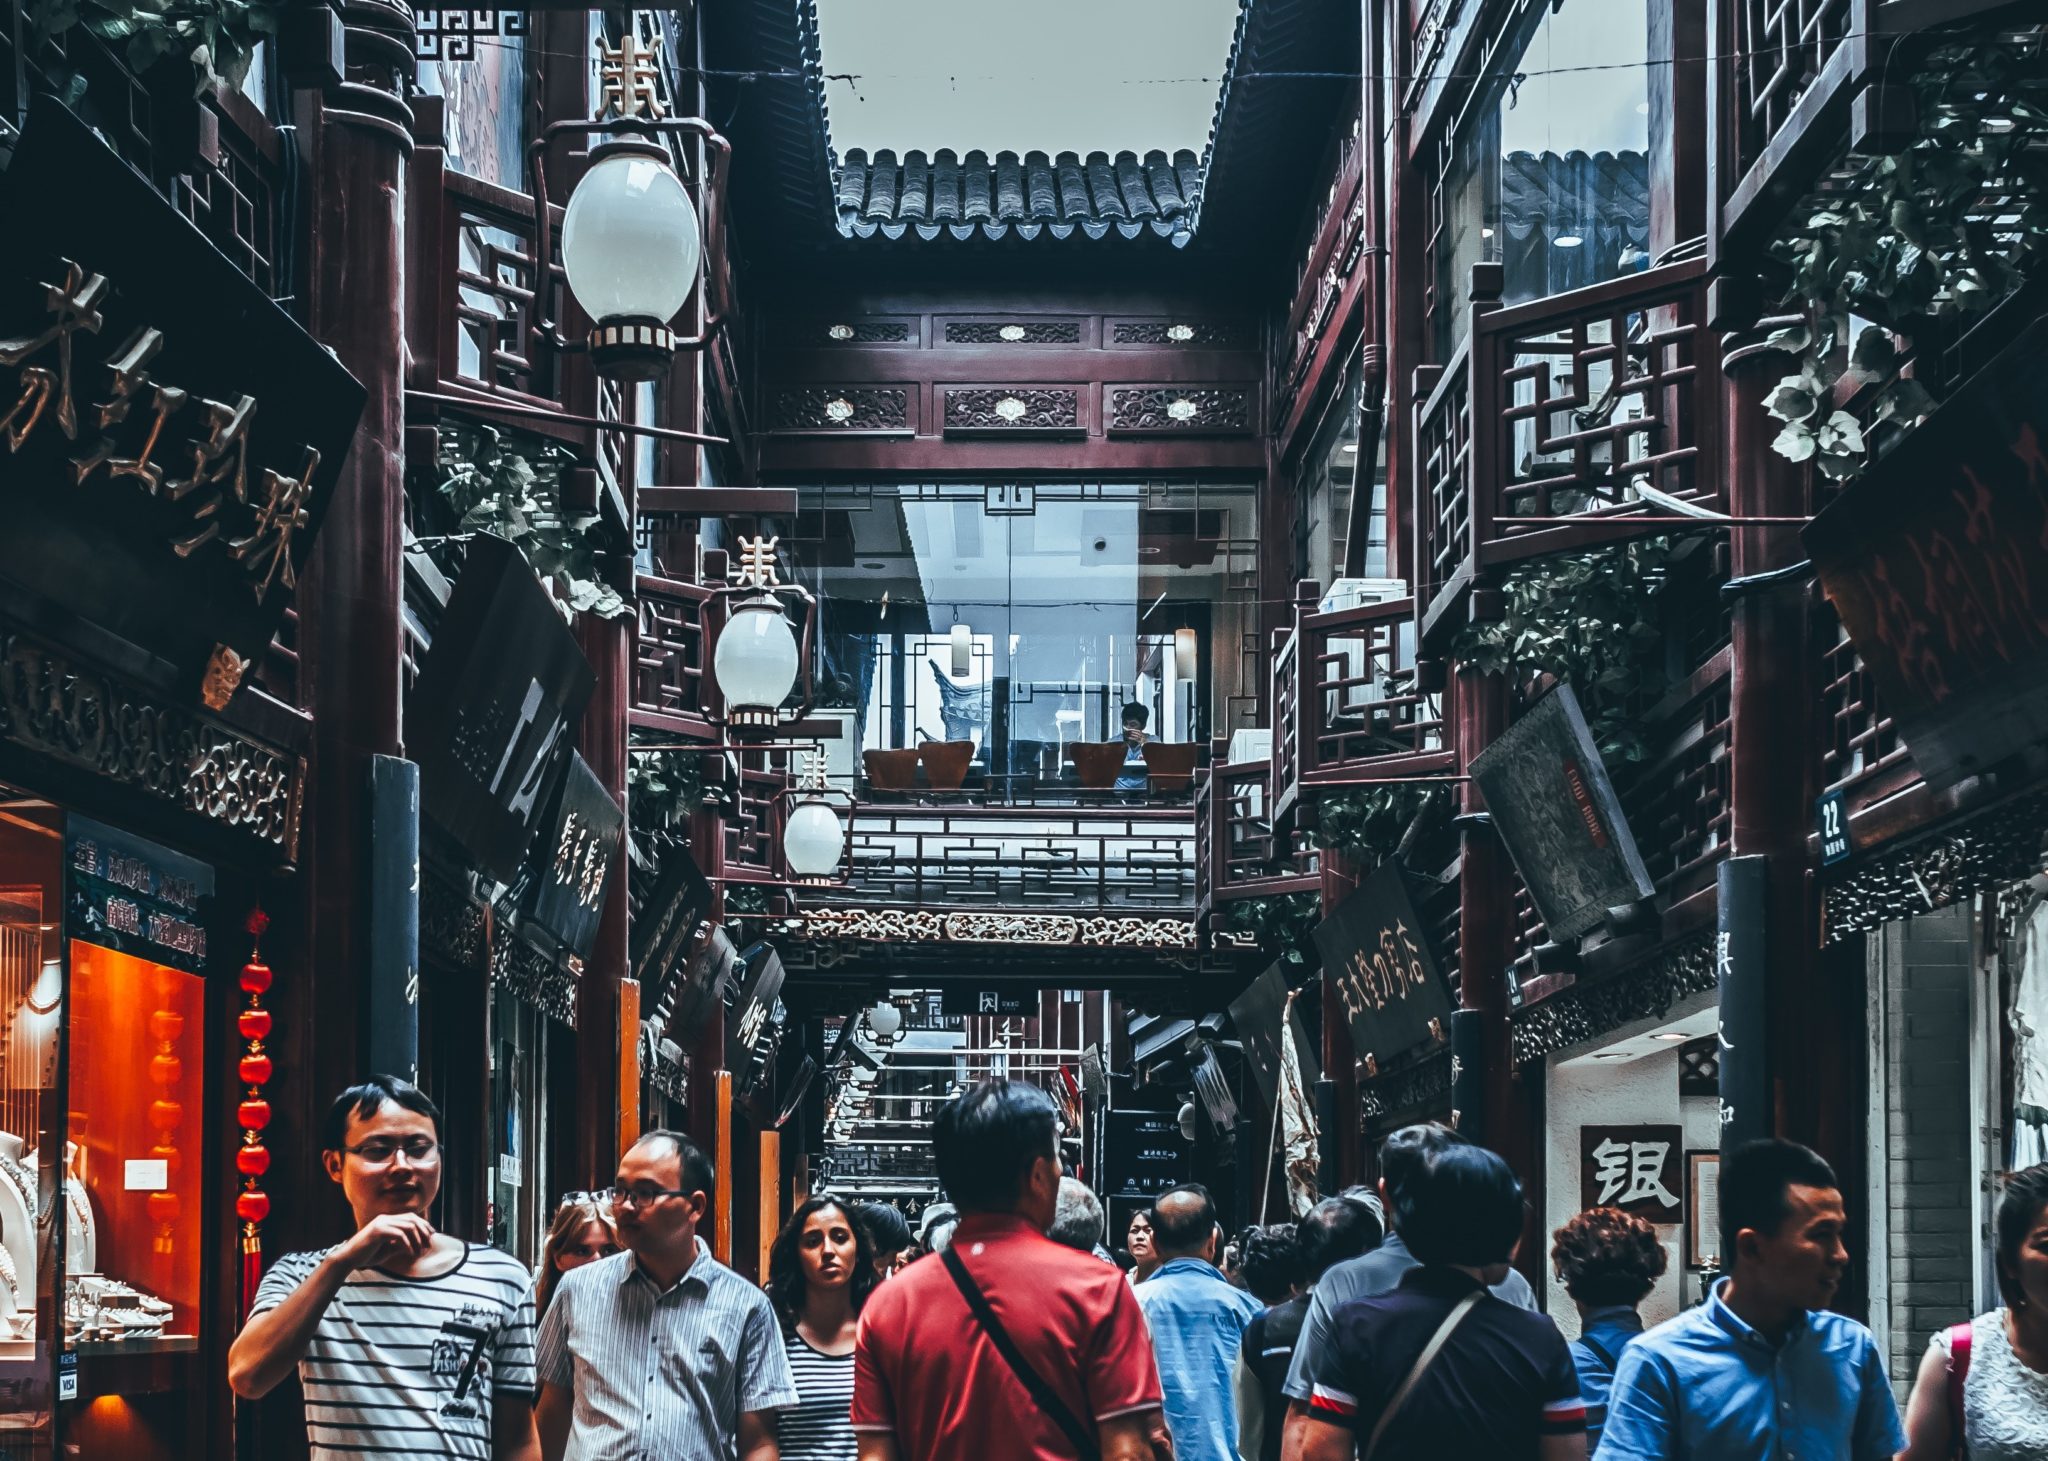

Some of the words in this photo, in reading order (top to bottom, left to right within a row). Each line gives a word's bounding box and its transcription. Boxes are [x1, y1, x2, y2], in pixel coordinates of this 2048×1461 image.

[1823, 800, 1840, 838] 22
[1591, 1137, 1681, 1208] 银
[62, 1378, 75, 1391] VISA
[440, 1320, 490, 1400] 7
